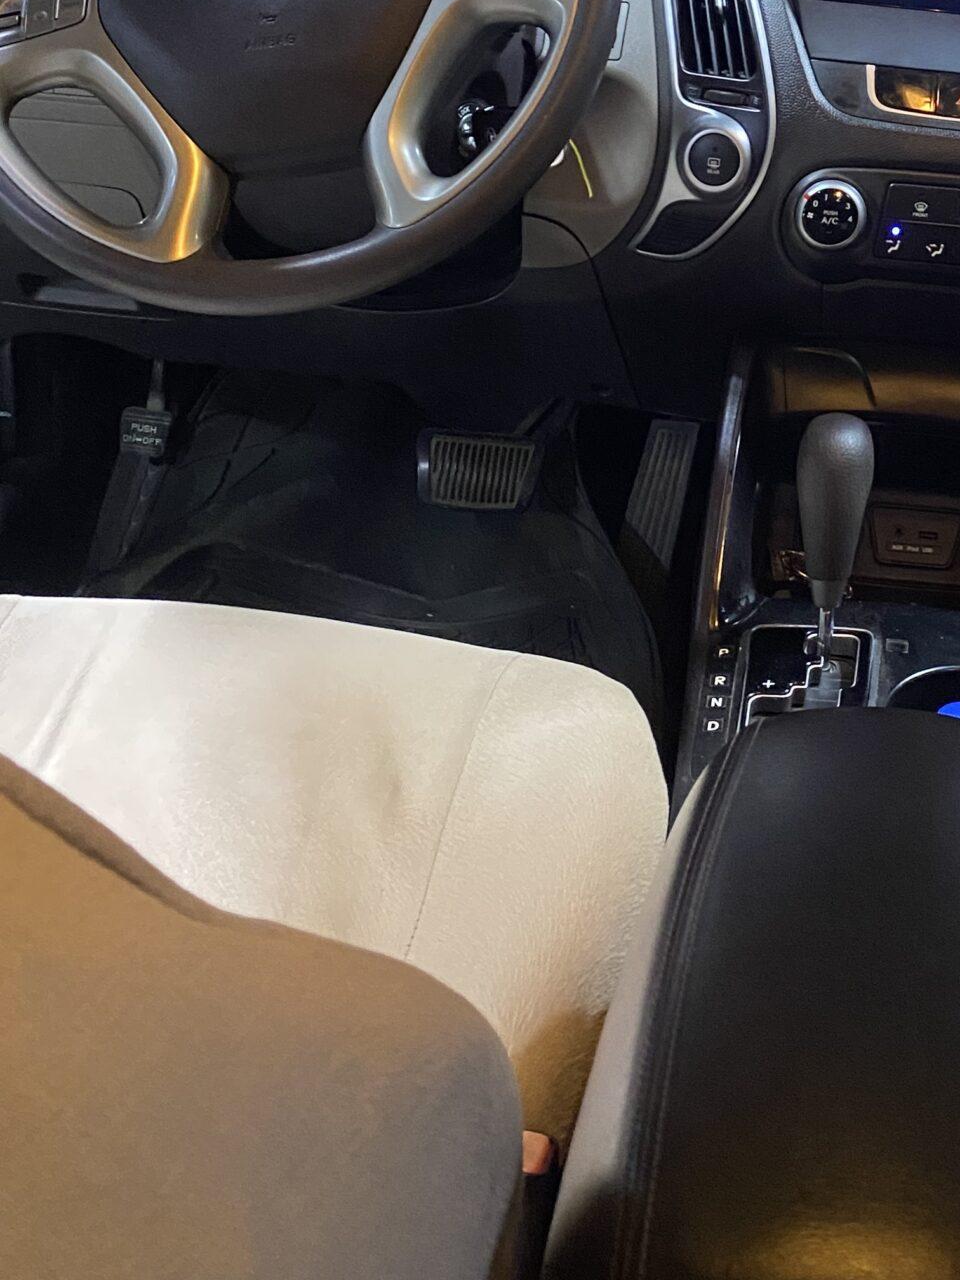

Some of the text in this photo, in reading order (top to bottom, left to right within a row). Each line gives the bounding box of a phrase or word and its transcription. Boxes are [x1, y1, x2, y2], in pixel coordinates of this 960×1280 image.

[812, 200, 819, 208] 0
[845, 202, 851, 210] 3
[821, 216, 839, 225] A/C
[847, 215, 853, 223] 4
[131, 423, 157, 434] PUSH
[719, 648, 730, 658] P
[714, 675, 727, 686] R
[711, 697, 723, 707] N
[707, 720, 720, 731] D
